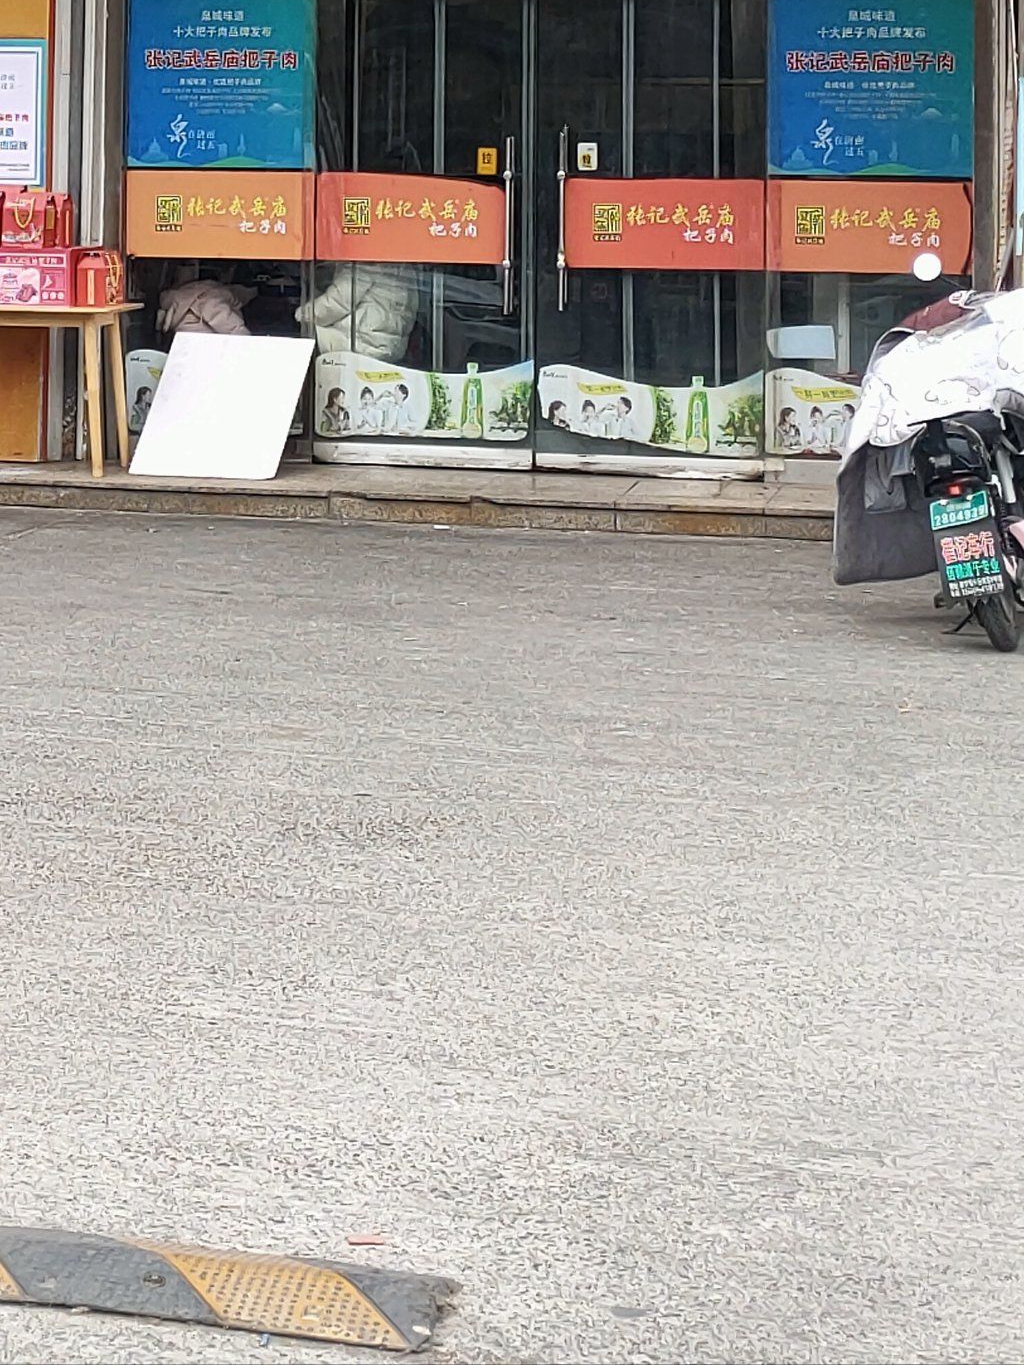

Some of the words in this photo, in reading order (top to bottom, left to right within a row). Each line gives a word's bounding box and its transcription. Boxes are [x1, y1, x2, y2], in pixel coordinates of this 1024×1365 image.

[201, 10, 244, 22] 泉城味道
[848, 10, 896, 22] 泉城味道
[173, 26, 272, 38] 十大把子肉品牌发布
[817, 26, 926, 39] 十大把子肉品牌发布
[145, 49, 298, 70] 张记武岳庙把子肉
[786, 50, 955, 73] 张记武岳庙把子肉
[187, 195, 288, 219] 张记武岳庙
[375, 197, 479, 222] 张记武岳庙
[626, 203, 734, 228] 张记武岳庙
[239, 220, 287, 234] 把子肉
[830, 206, 942, 232] 张记武岳庙
[428, 221, 478, 238] 把子肉
[682, 227, 734, 244] 把子肉
[888, 233, 941, 248] 把子肉
